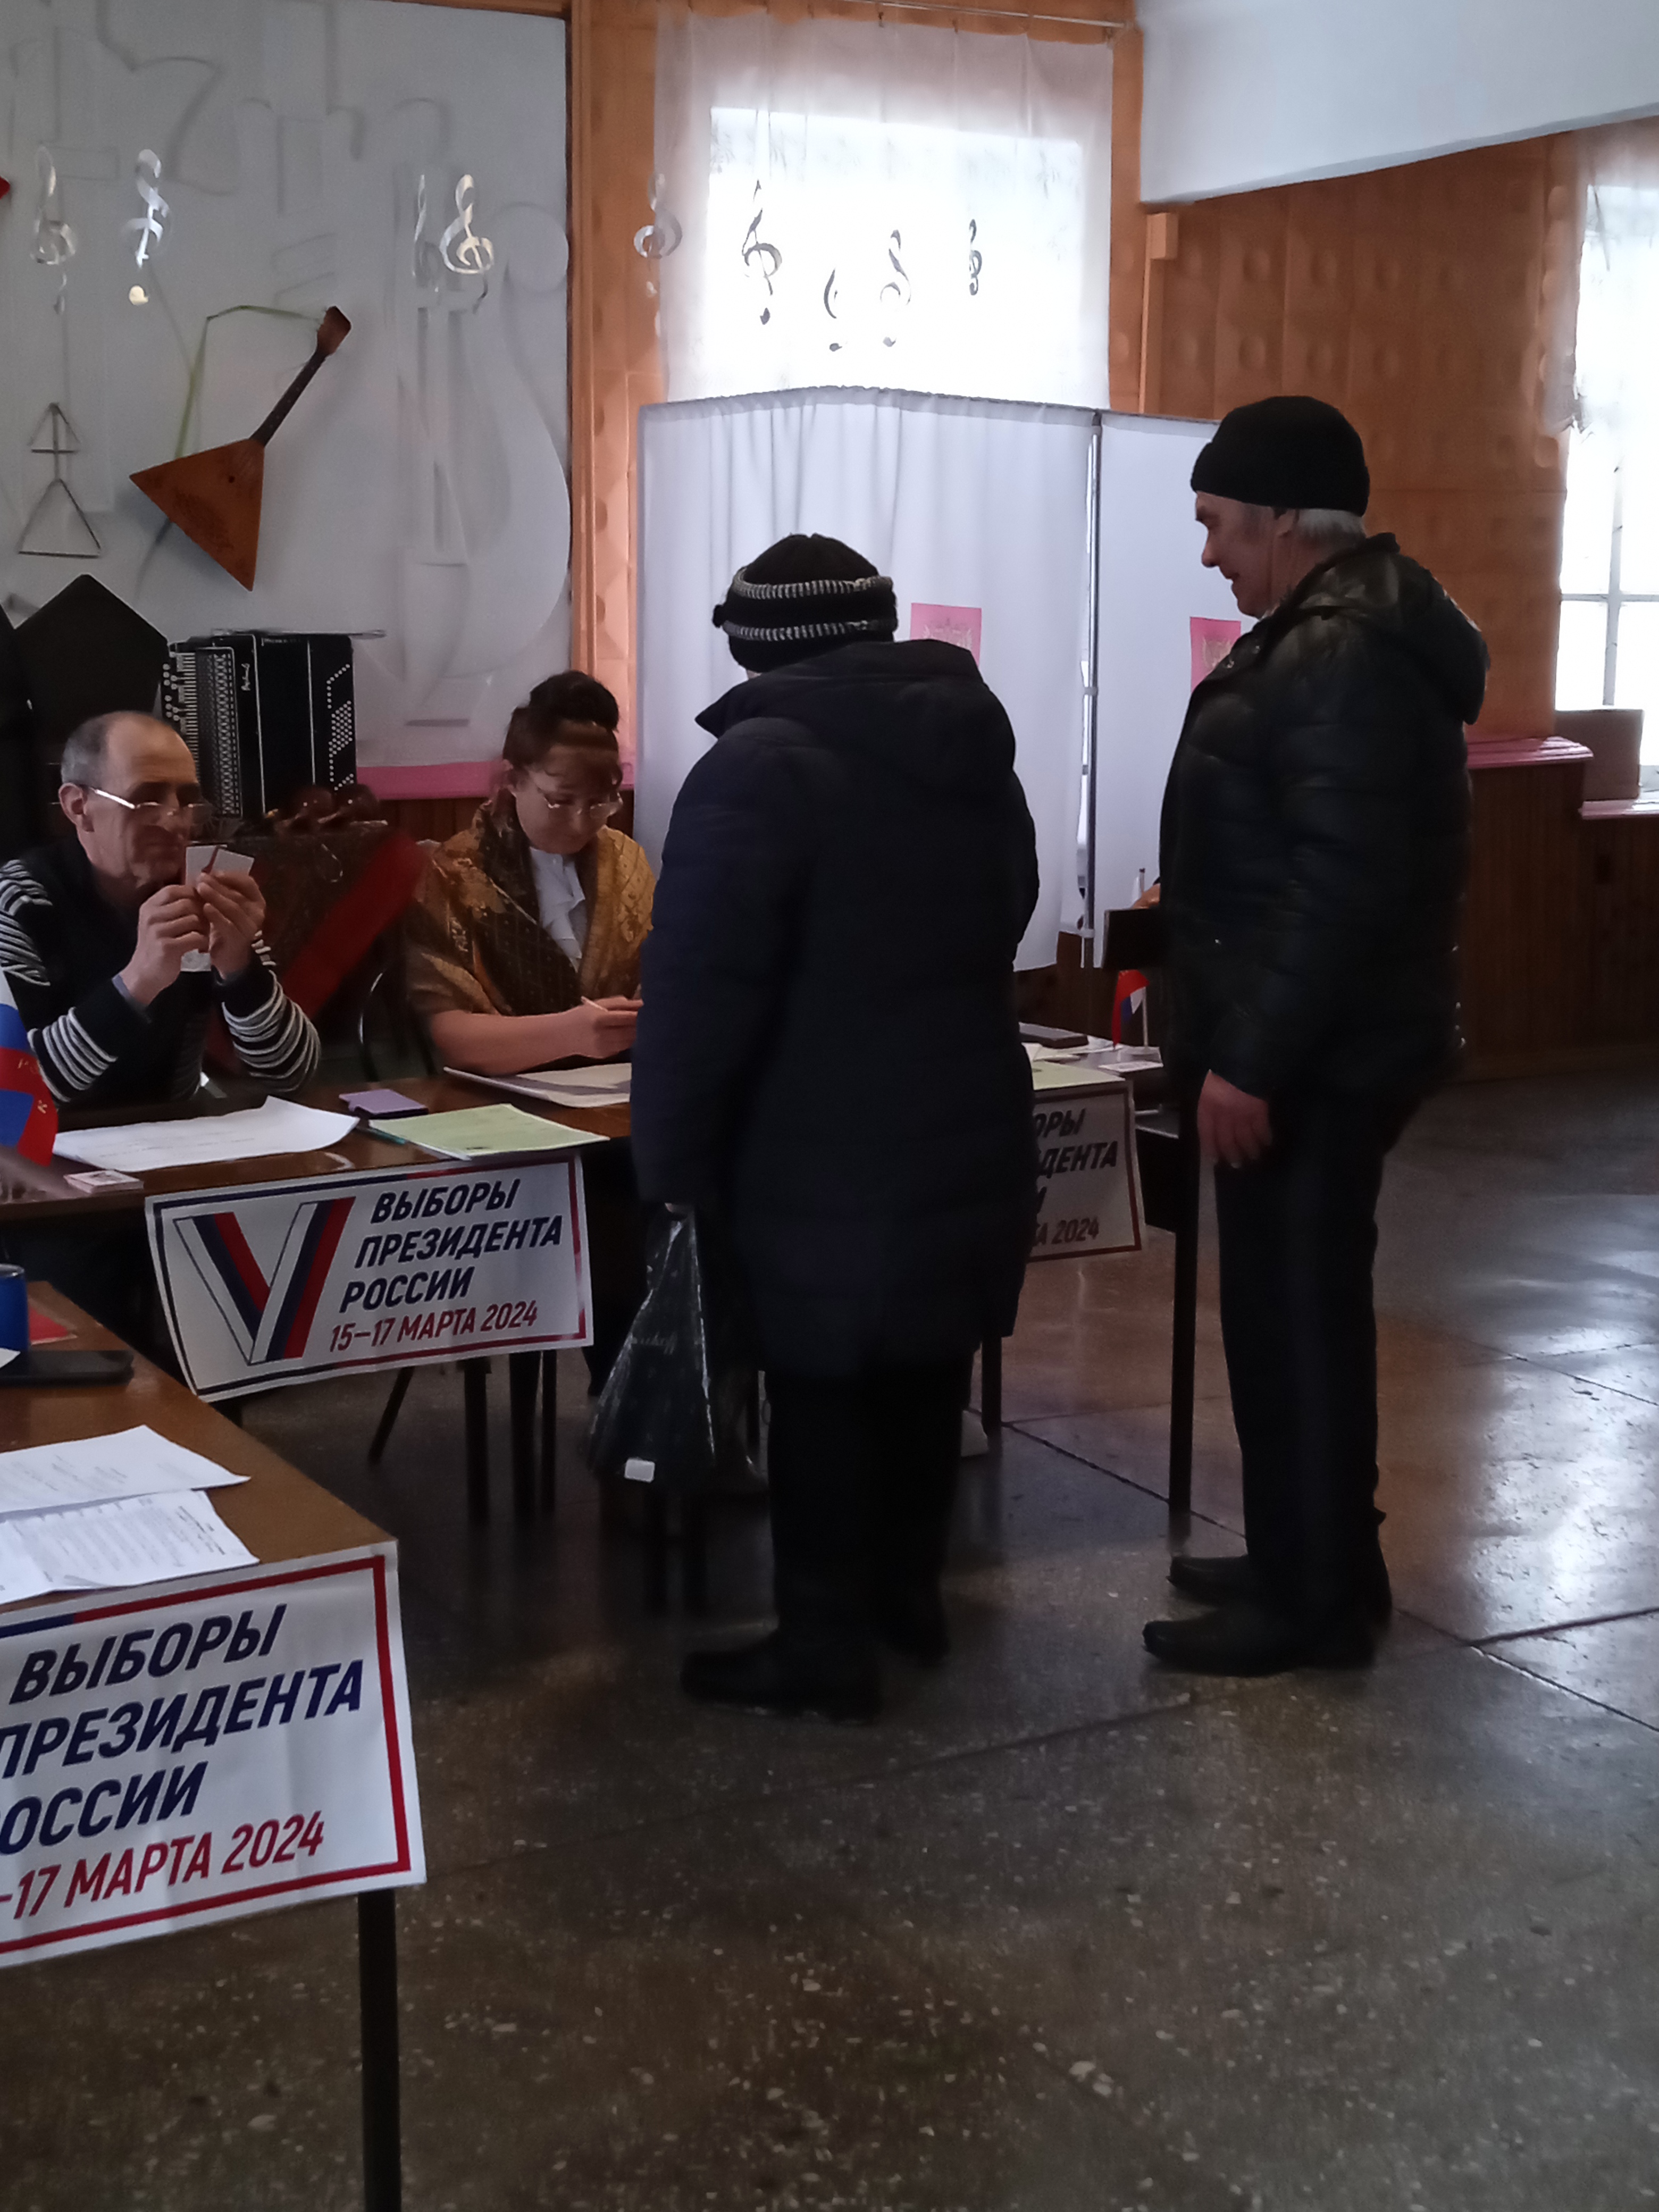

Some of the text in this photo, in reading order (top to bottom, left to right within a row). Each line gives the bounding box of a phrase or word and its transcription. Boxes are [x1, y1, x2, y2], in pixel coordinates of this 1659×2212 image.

[1037, 1141, 1118, 1179] ДЕНТА
[370, 1178, 521, 1224] ВЫБОРЫ
[354, 1215, 563, 1269] ПРЕЗИДЕНТА
[1051, 1217, 1099, 1245] 2024
[339, 1266, 475, 1313] РОССИИ
[397, 1307, 476, 1343] МАРТА
[480, 1300, 538, 1331] 2024
[9, 1604, 288, 1704] ВЫБОРЫ
[0, 1659, 364, 1779] ПРЕЗИДЕНТА
[0, 1761, 208, 1855] ОССИИ
[63, 1831, 212, 1909] МАРТА
[221, 1810, 325, 1875] 2024
